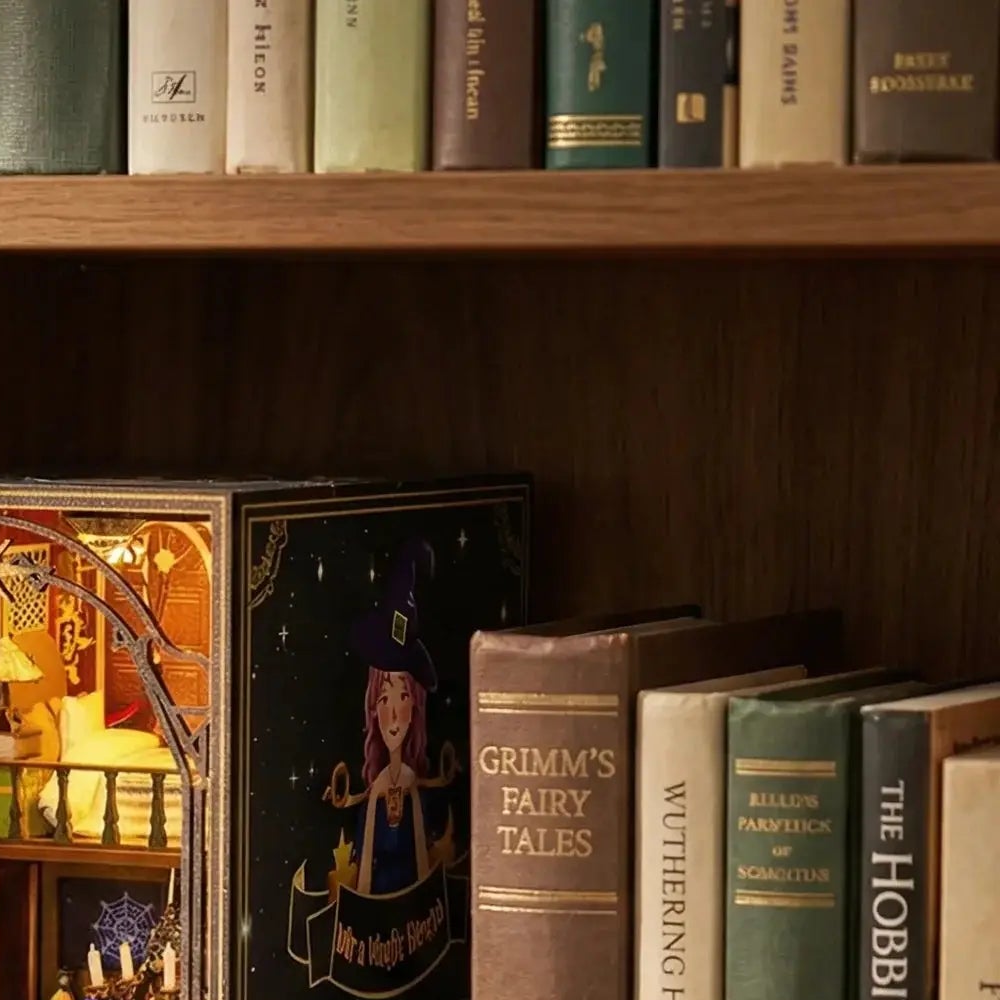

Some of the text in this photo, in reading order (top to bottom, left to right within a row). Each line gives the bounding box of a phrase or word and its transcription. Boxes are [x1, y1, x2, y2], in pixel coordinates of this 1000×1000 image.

[479, 745, 616, 778] GRIMM'S
[501, 786, 591, 817] FAIRY
[880, 780, 905, 841] THE
[497, 826, 593, 857] TALES
[661, 781, 687, 976] WUTHERING
